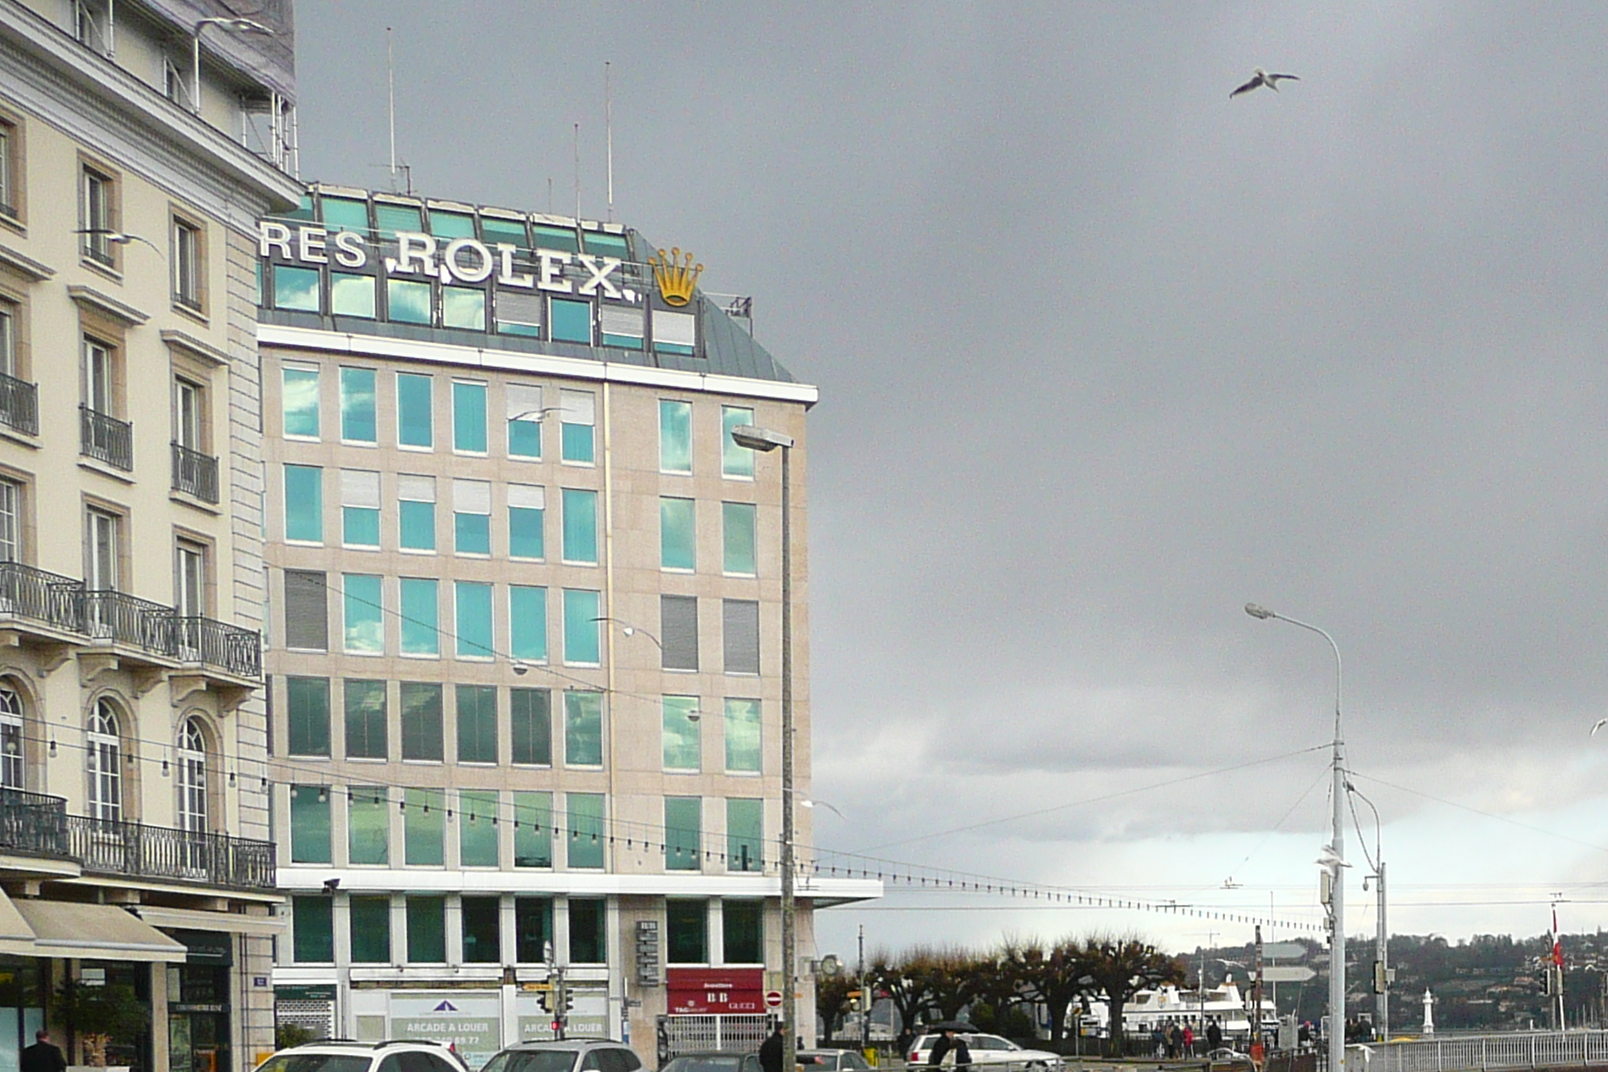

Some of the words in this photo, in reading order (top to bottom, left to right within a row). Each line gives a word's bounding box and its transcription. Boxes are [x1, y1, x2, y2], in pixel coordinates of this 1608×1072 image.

[260, 221, 366, 268] RES
[395, 230, 622, 299] ROLEX
[407, 1023, 446, 1032] ARCADE
[448, 1023, 456, 1032] A
[458, 1023, 489, 1032] LOUER
[573, 1023, 603, 1032] LOUER
